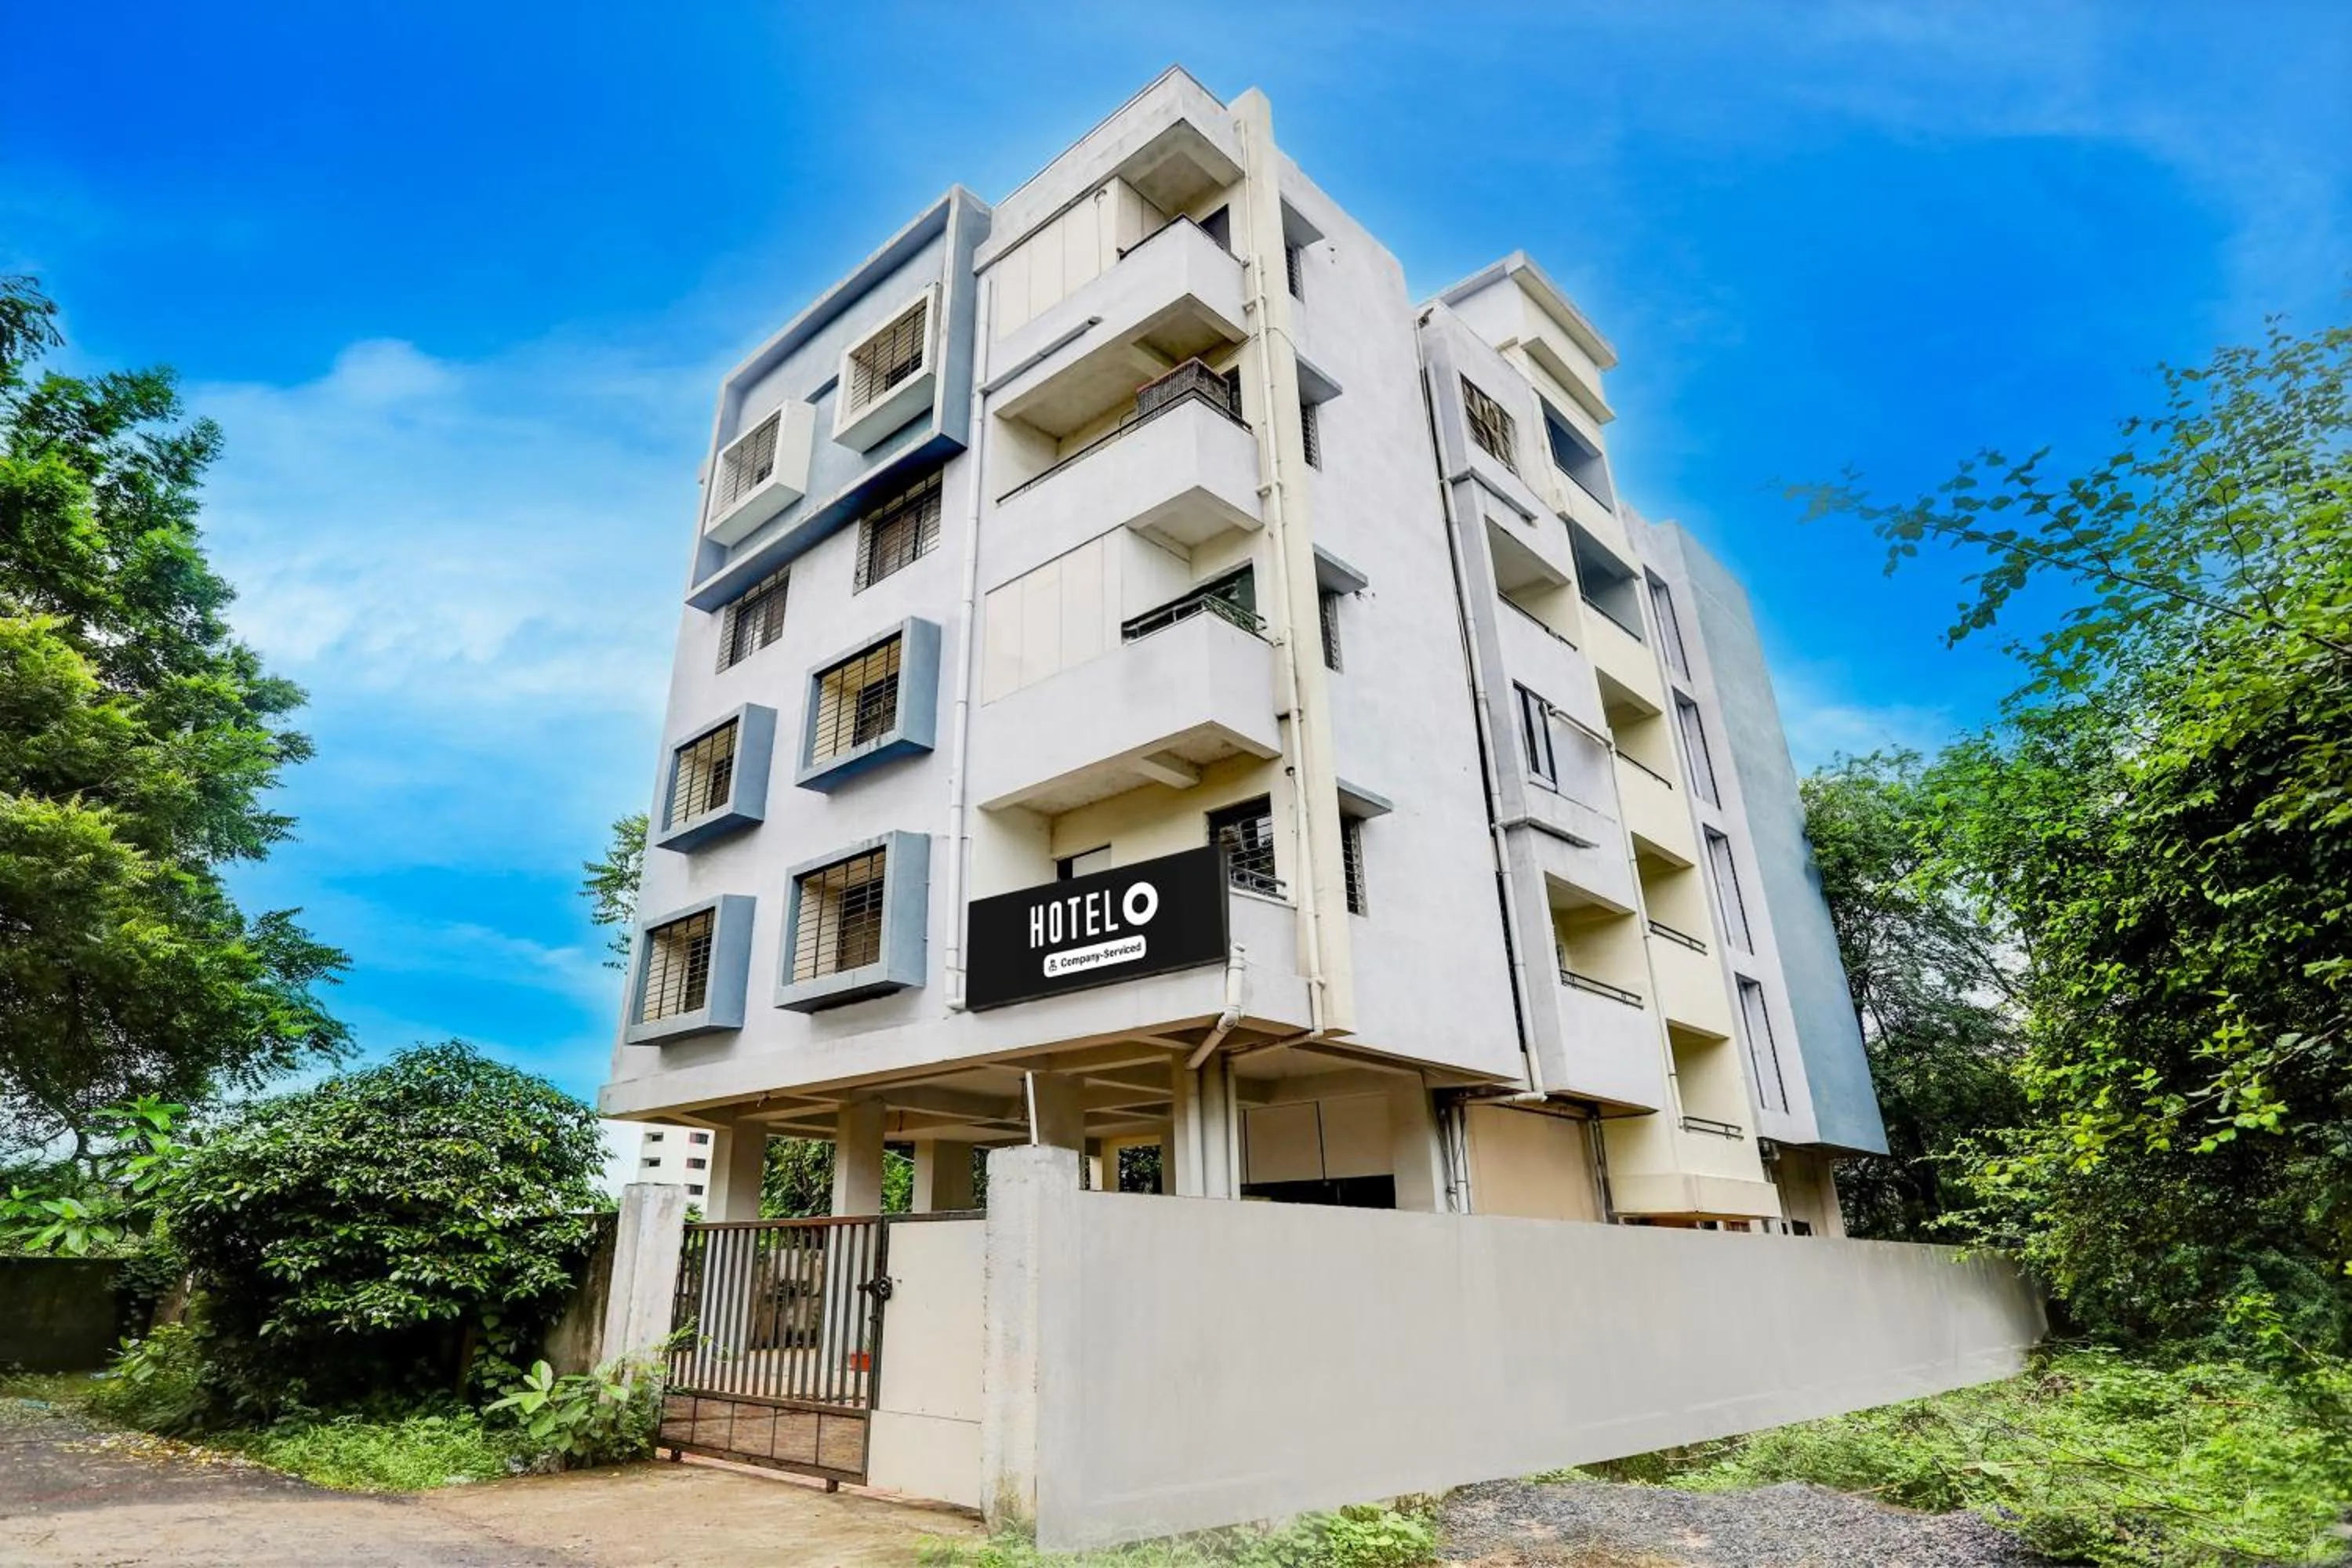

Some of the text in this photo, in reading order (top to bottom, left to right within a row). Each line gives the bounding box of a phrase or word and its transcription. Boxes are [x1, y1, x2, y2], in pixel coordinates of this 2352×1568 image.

[1030, 881, 1159, 948] HOTEL O
[1061, 942, 1142, 968] Company-Serviced
